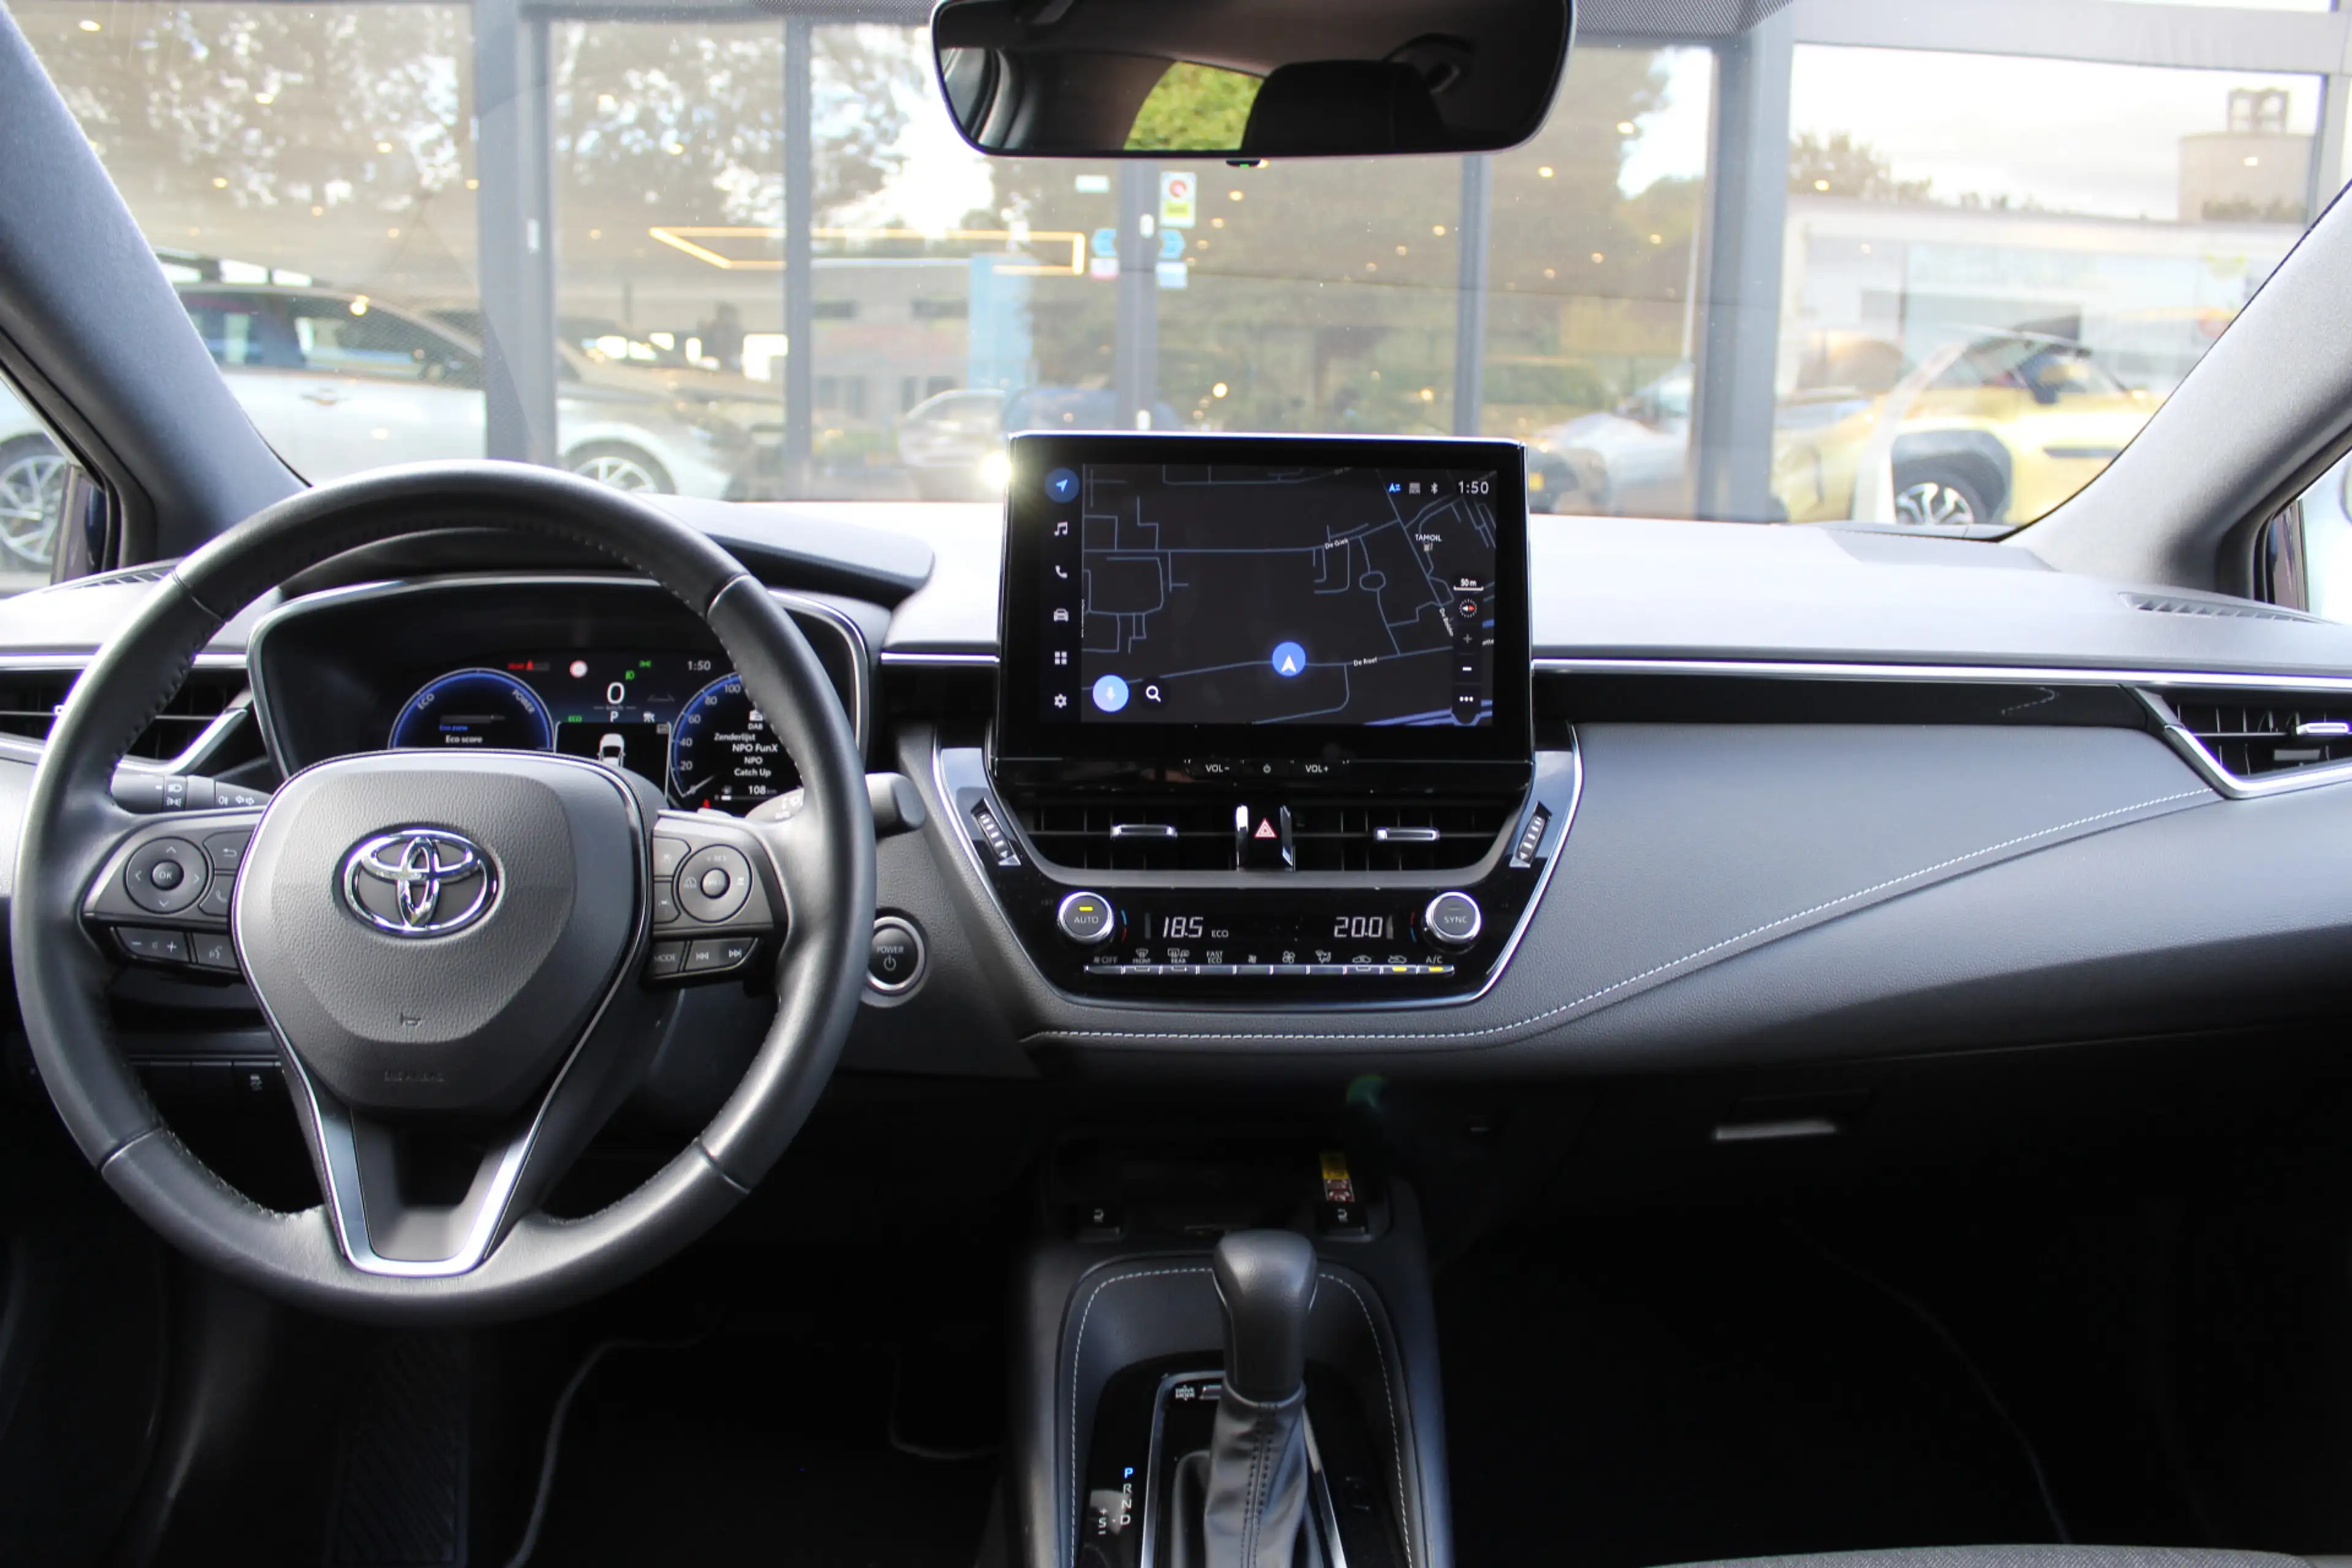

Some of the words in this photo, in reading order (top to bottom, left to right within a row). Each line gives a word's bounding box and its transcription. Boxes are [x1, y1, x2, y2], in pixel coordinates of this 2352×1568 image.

[1458, 481, 1489, 494] 1:50
[1460, 578, 1469, 587] 50
[687, 660, 711, 671] 1:50
[606, 681, 625, 704] 0
[725, 684, 741, 693] 100
[417, 693, 435, 710] ECO
[512, 688, 535, 714] POWER
[704, 695, 718, 706] 80
[610, 710, 619, 723] P
[688, 714, 701, 724] 60
[445, 734, 461, 744] Eco
[680, 737, 693, 747] 40
[714, 733, 756, 743] Zenderlijst
[732, 744, 753, 753] NPO
[755, 744, 778, 753] FunX
[680, 760, 693, 771] 20
[744, 756, 763, 765] NPO
[734, 768, 758, 777] Catch
[759, 768, 772, 778] Up
[748, 785, 767, 795] 108
[159, 870, 173, 880] OK
[1074, 916, 1099, 925] AUTO
[1444, 916, 1468, 924] SYNC
[1163, 916, 1204, 938] 18.5
[1333, 916, 1383, 938] 20.0
[876, 945, 905, 954] POWER
[654, 953, 676, 962] MODE
[1101, 956, 1118, 964] OFF
[1425, 955, 1443, 964] A/C
[1125, 1467, 1133, 1479] P
[1123, 1483, 1133, 1494] R
[1121, 1499, 1132, 1510] N
[1098, 1517, 1107, 1529] S
[1120, 1514, 1131, 1525] D
